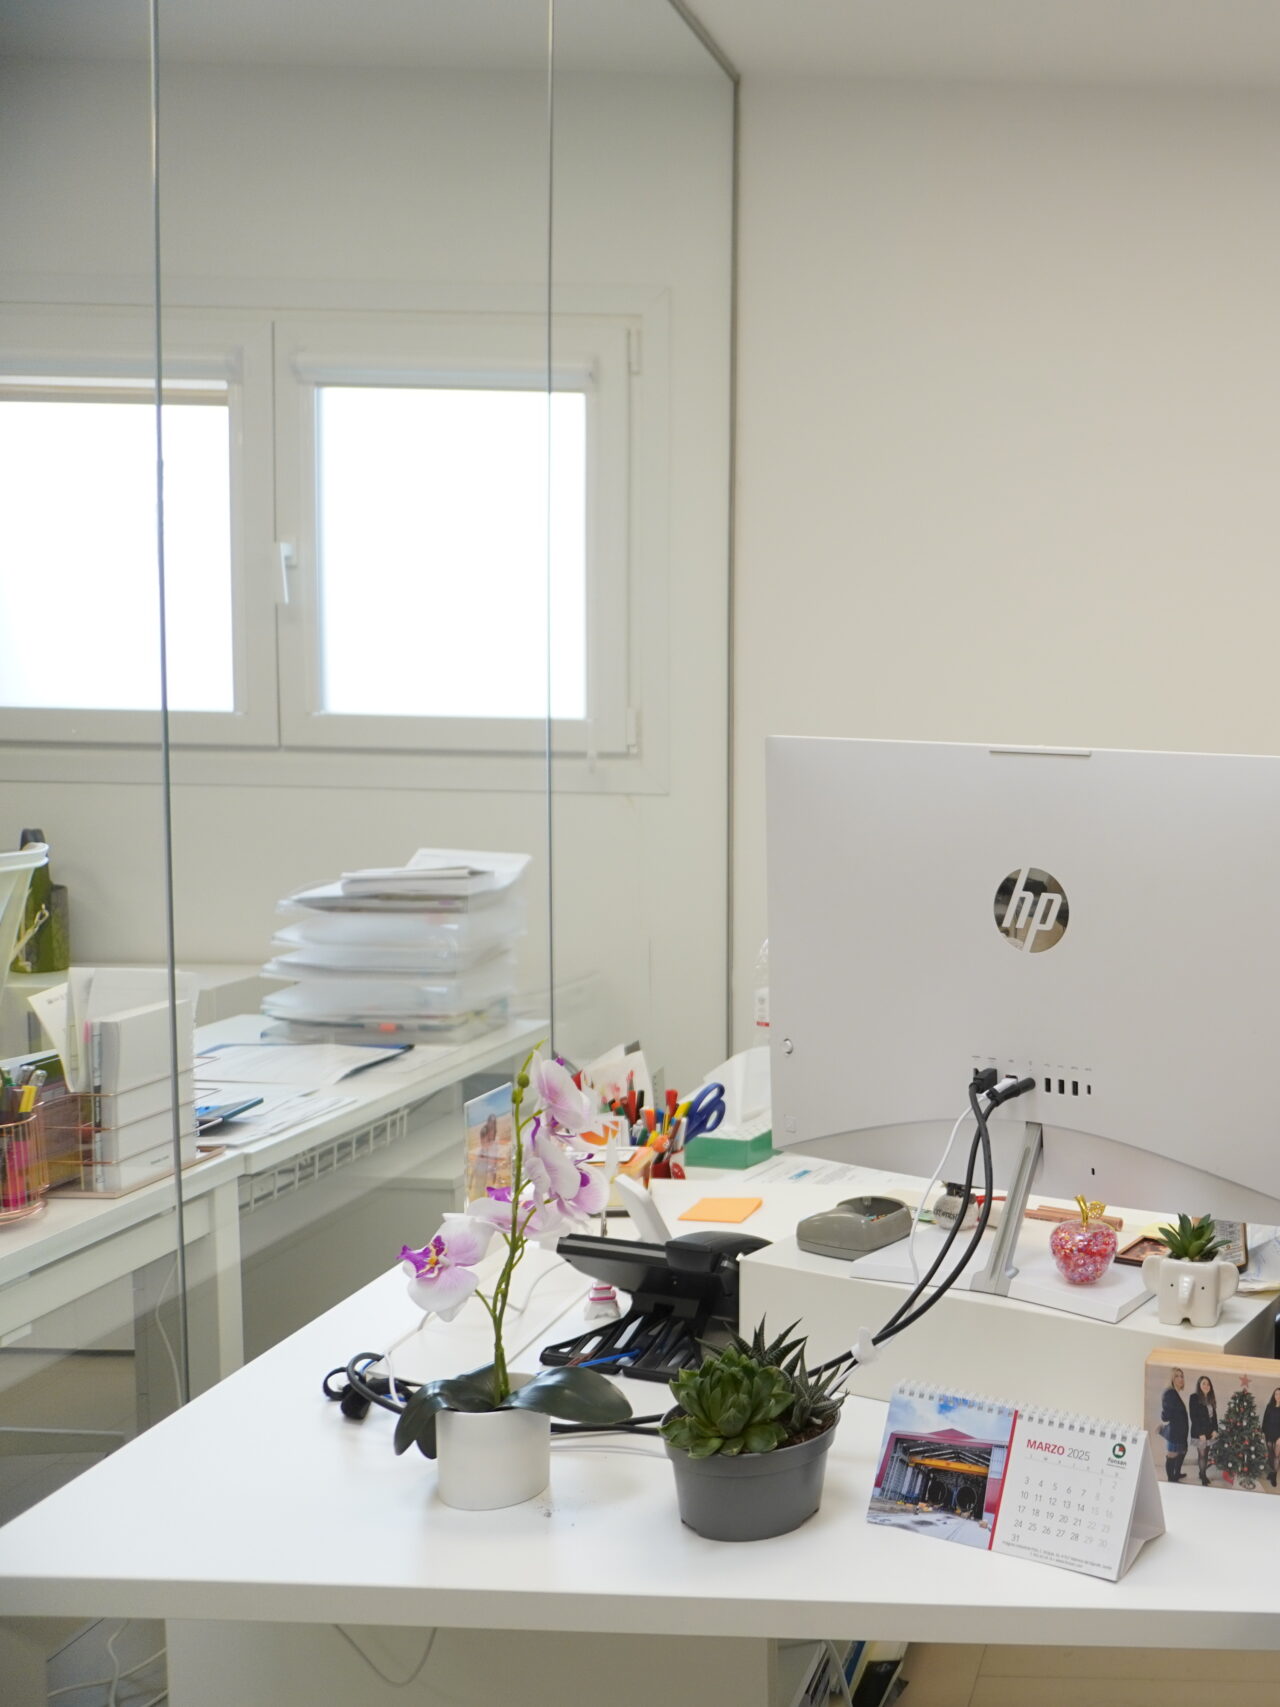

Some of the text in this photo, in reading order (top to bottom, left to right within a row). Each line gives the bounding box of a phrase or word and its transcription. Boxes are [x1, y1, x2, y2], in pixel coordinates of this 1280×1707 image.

[1000, 867, 1063, 953] hp
[1026, 1439, 1091, 1462] MARZO 2025
[1024, 1476, 1030, 1485] 3
[1038, 1480, 1044, 1488] 4
[1052, 1482, 1058, 1491] 5
[1066, 1486, 1072, 1494] 6
[1080, 1488, 1087, 1497] 7
[1020, 1490, 1029, 1500] 10
[1035, 1493, 1042, 1503] 11
[1049, 1496, 1057, 1506] 12
[1063, 1500, 1072, 1510] 13
[1077, 1503, 1086, 1512] 14
[1018, 1504, 1026, 1513] 17
[1032, 1508, 1040, 1517] 18
[1046, 1511, 1054, 1520] 19
[1058, 1514, 1068, 1524] 20
[1072, 1517, 1082, 1527] 21
[1011, 1533, 1020, 1542] 31
[1014, 1518, 1023, 1528] 24
[1027, 1522, 1037, 1532] 25
[1042, 1526, 1051, 1535] 26
[1056, 1528, 1066, 1538] 27
[1070, 1532, 1080, 1542] 28
